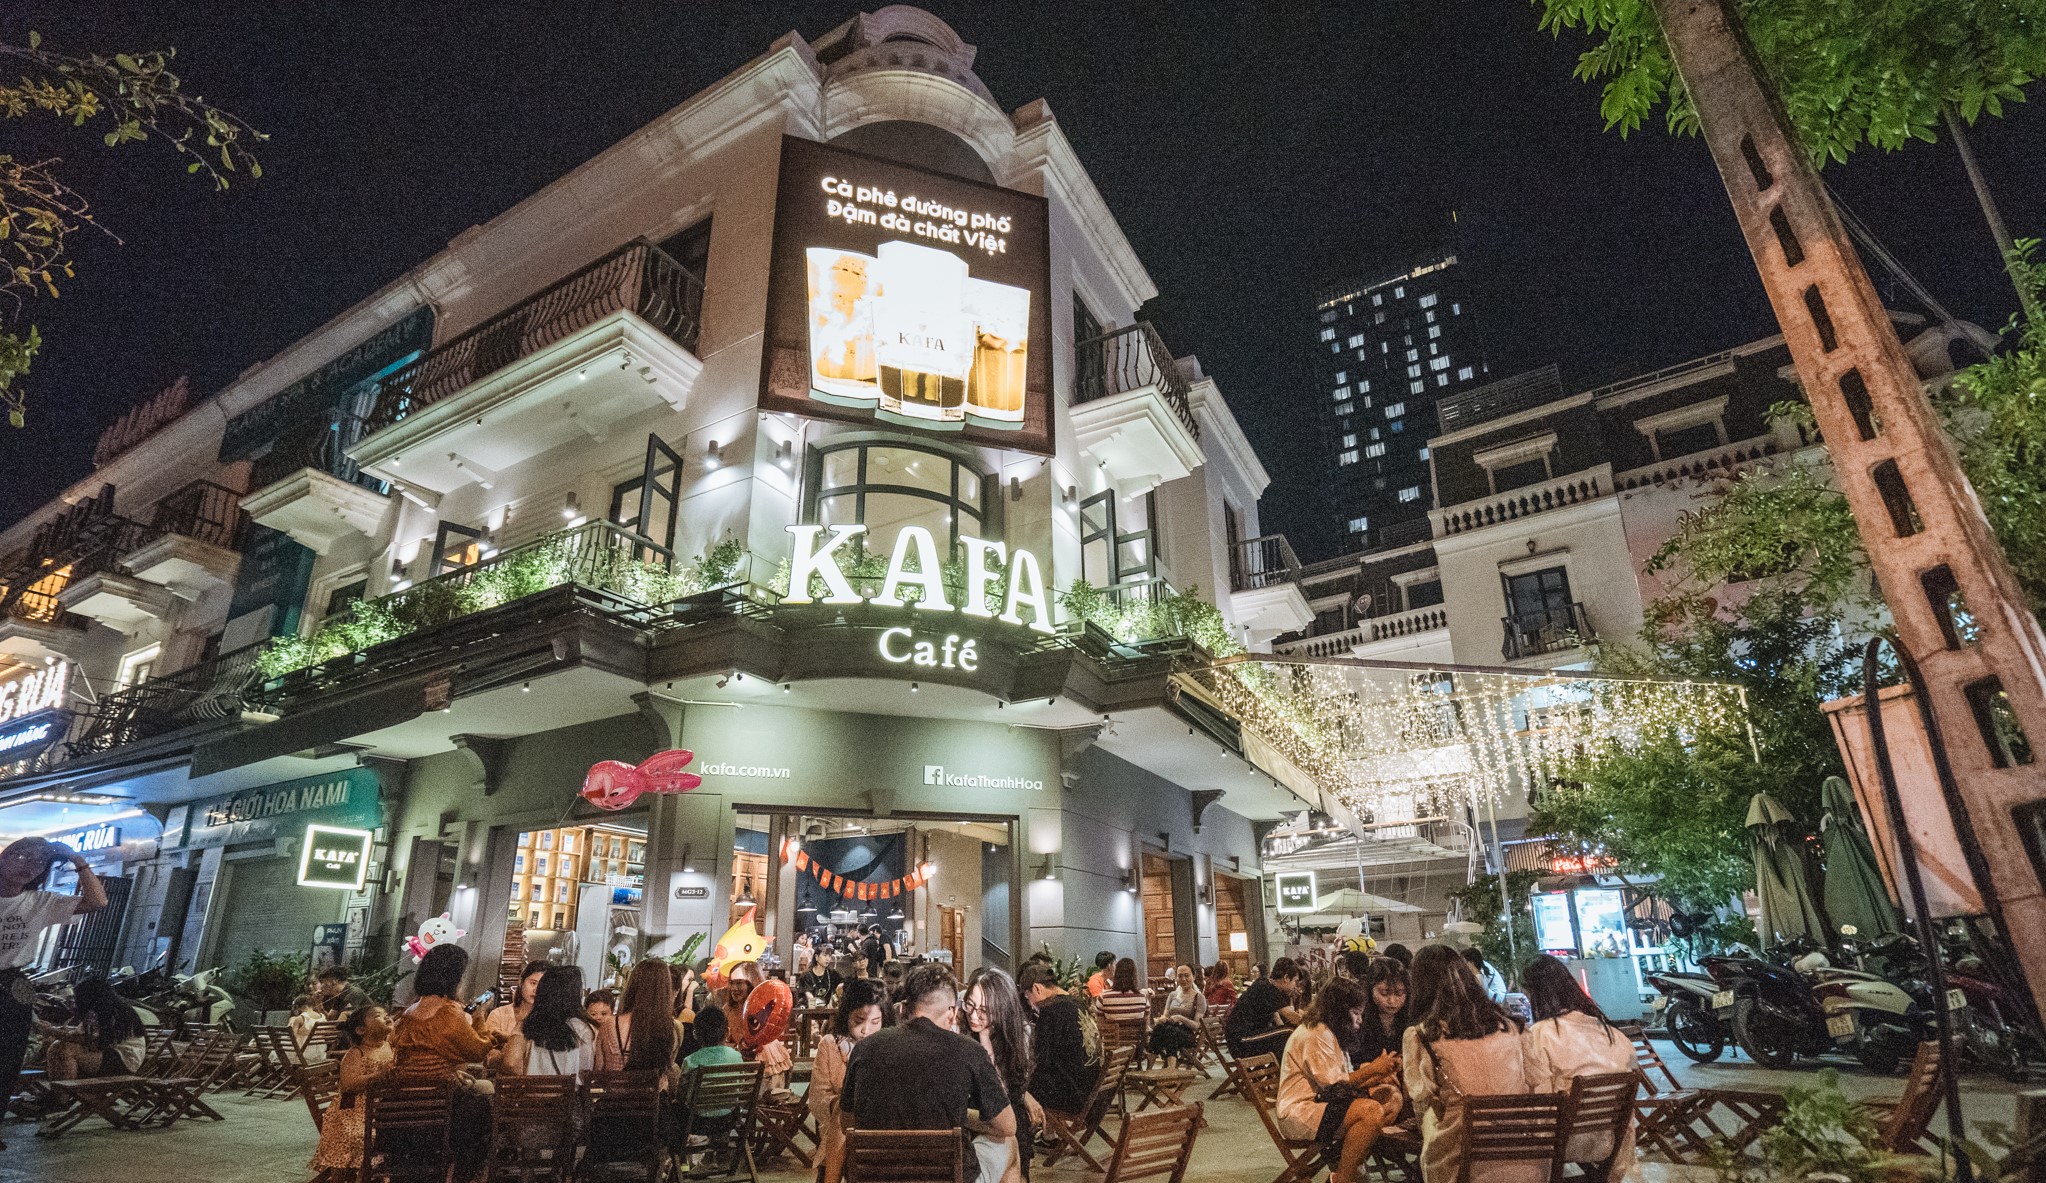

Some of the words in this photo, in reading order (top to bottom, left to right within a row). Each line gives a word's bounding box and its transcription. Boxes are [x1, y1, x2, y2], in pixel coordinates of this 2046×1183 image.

[821, 176, 853, 198] Cà
[857, 185, 897, 208] phê
[901, 195, 968, 226] đường
[971, 211, 1012, 233] phố
[827, 199, 876, 225] Đậm
[880, 213, 911, 232] đà
[914, 222, 961, 243] chất
[963, 230, 1007, 256] Việt
[897, 331, 946, 352] KAFA
[778, 524, 1056, 635] KAFA
[878, 627, 979, 672] Café
[700, 761, 790, 779] kafa.com.vn
[945, 773, 1043, 791] KafaThanhHoa
[263, 790, 297, 816] HOA
[300, 780, 350, 809] NAMI
[314, 848, 356, 864] KAFA
[1282, 885, 1310, 896] KAFA
[2, 922, 26, 931] NOT
